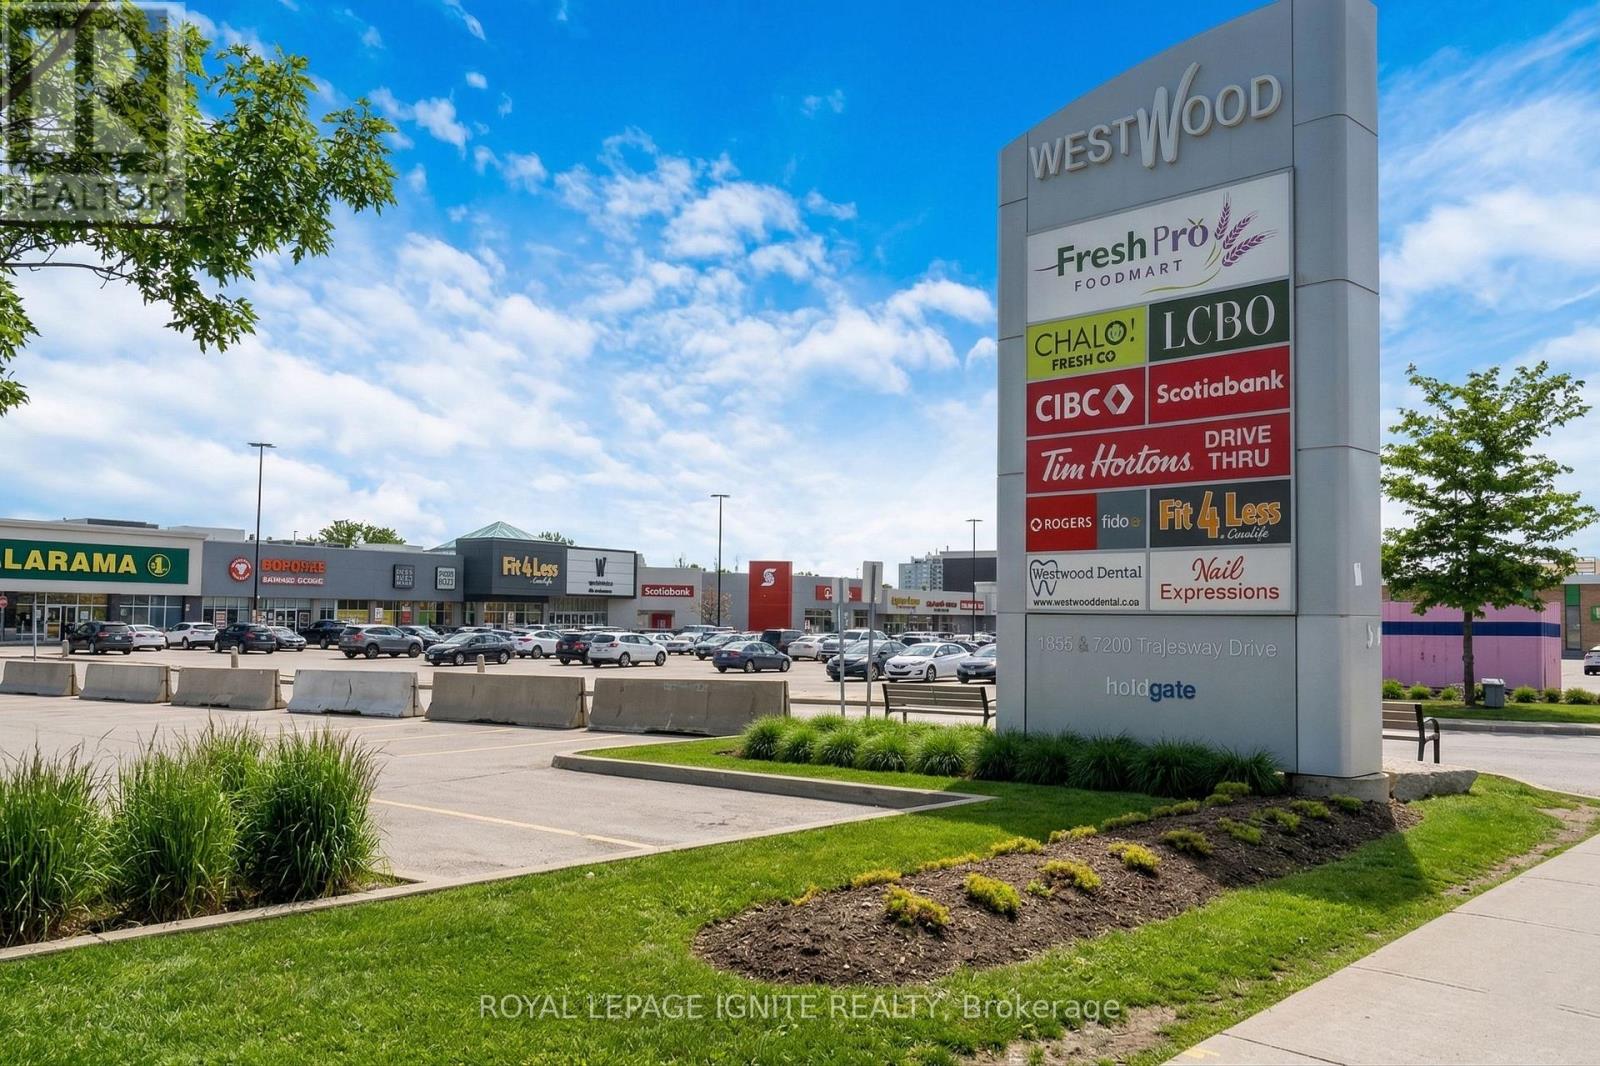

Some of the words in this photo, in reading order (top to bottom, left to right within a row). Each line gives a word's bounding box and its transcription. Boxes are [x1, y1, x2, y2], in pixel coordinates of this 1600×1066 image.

[1030, 62, 1283, 180] WESTWOOD
[1056, 231, 1147, 277] Fresh
[1153, 219, 1209, 256] Pro
[1073, 259, 1183, 292] FOODMART
[1162, 294, 1276, 351] LCBO
[1034, 317, 1136, 358] CHALO!
[1051, 353, 1094, 371] FRESH
[1096, 350, 1116, 365] CO
[1156, 369, 1285, 405] Scotiabank
[1035, 388, 1101, 423] CIBC
[1204, 424, 1272, 449] DRIVE
[1040, 447, 1084, 483] Tim
[1089, 442, 1192, 479] Hortons
[1207, 448, 1270, 471] THRU
[1044, 516, 1093, 530] ROGERS
[1101, 513, 1129, 529] fido
[1159, 498, 1194, 531] Fit
[1196, 490, 1220, 539] 4
[1225, 491, 1282, 527] Less
[0, 548, 137, 575] LARAMA
[503, 556, 521, 576] Fit
[521, 555, 533, 578] 4
[532, 556, 560, 578] Less
[1032, 566, 1094, 580] Westwood
[1097, 565, 1142, 579] Dental
[1192, 555, 1245, 582] Nail
[644, 586, 691, 597] Scotiabank
[1160, 582, 1280, 604] Expressions
[1093, 636, 1132, 653] 7200
[1229, 639, 1278, 658] Drive
[1105, 677, 1197, 702] holdgate
